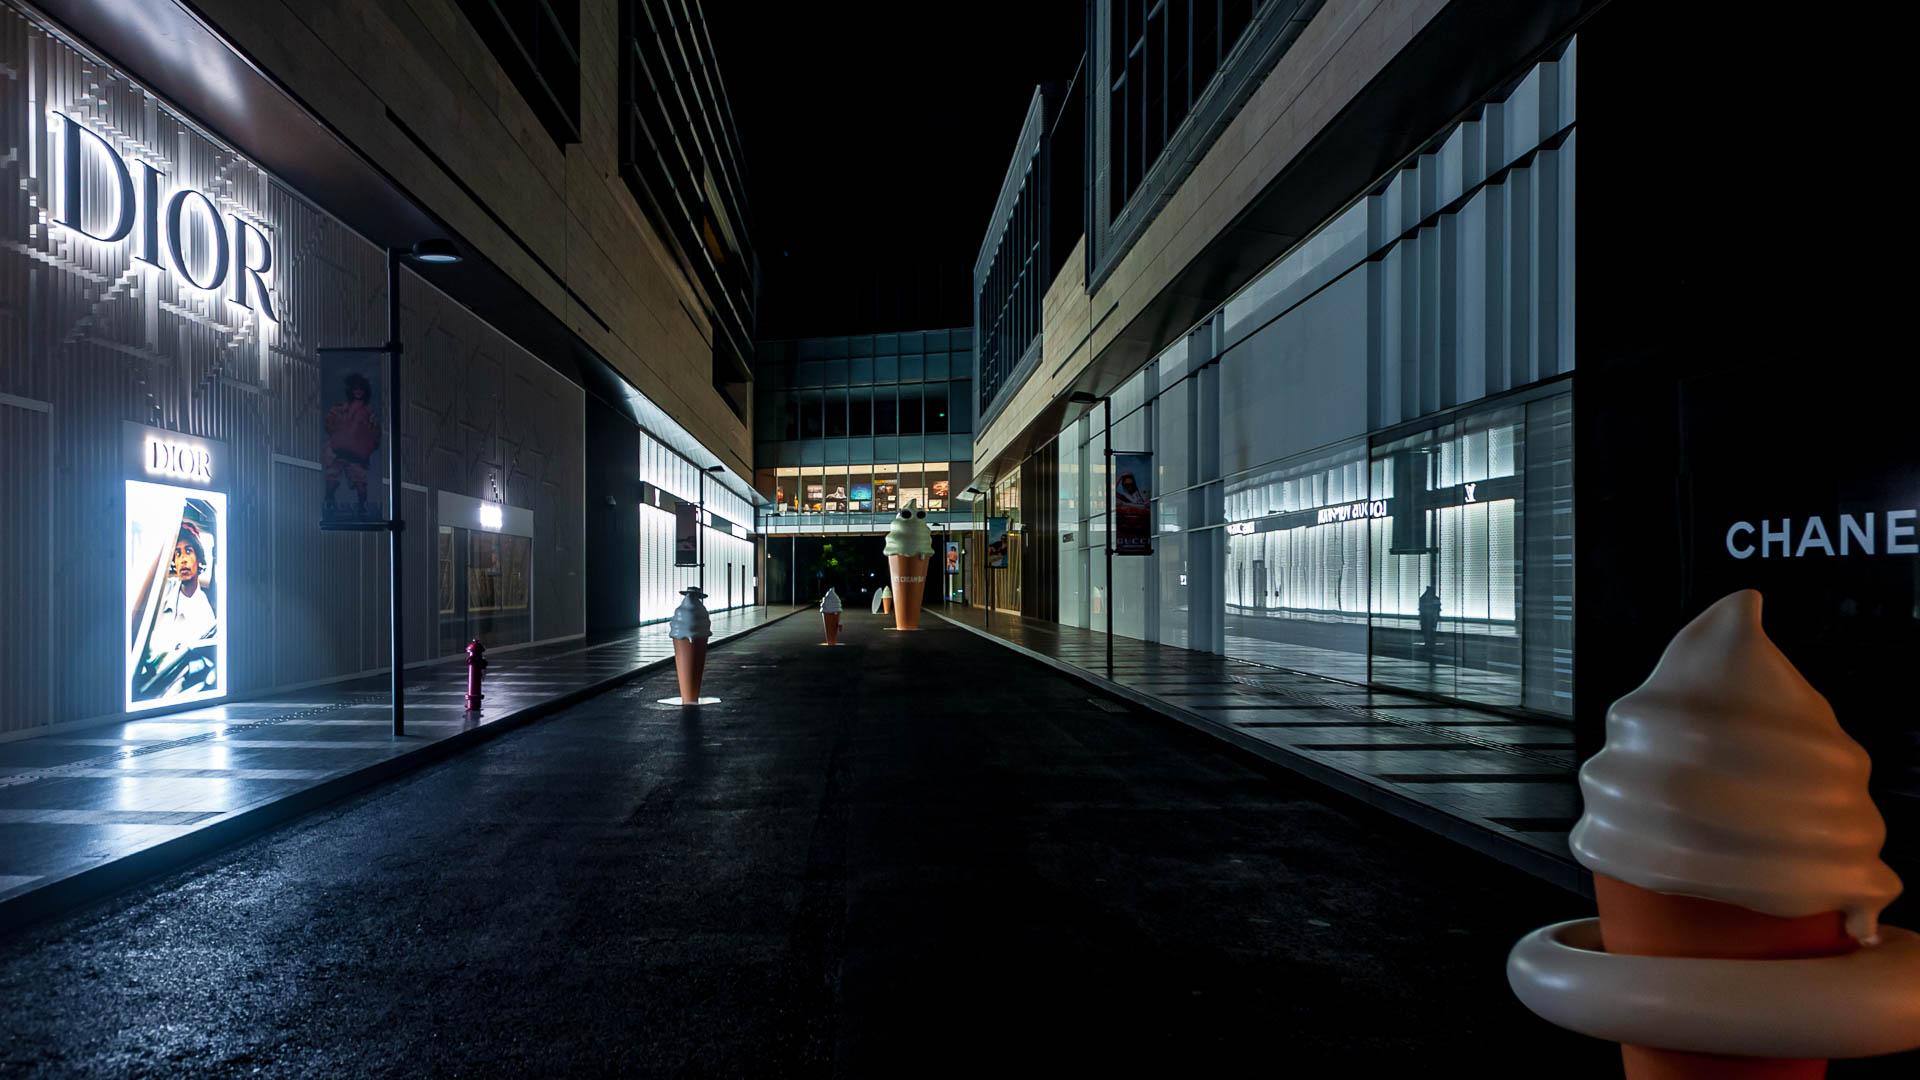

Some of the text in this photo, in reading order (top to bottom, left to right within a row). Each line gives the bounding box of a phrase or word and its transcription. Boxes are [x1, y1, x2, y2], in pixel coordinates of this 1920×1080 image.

[52, 110, 280, 323] DIOR
[148, 440, 214, 480] DIOR
[1725, 509, 1920, 560] CHANE
